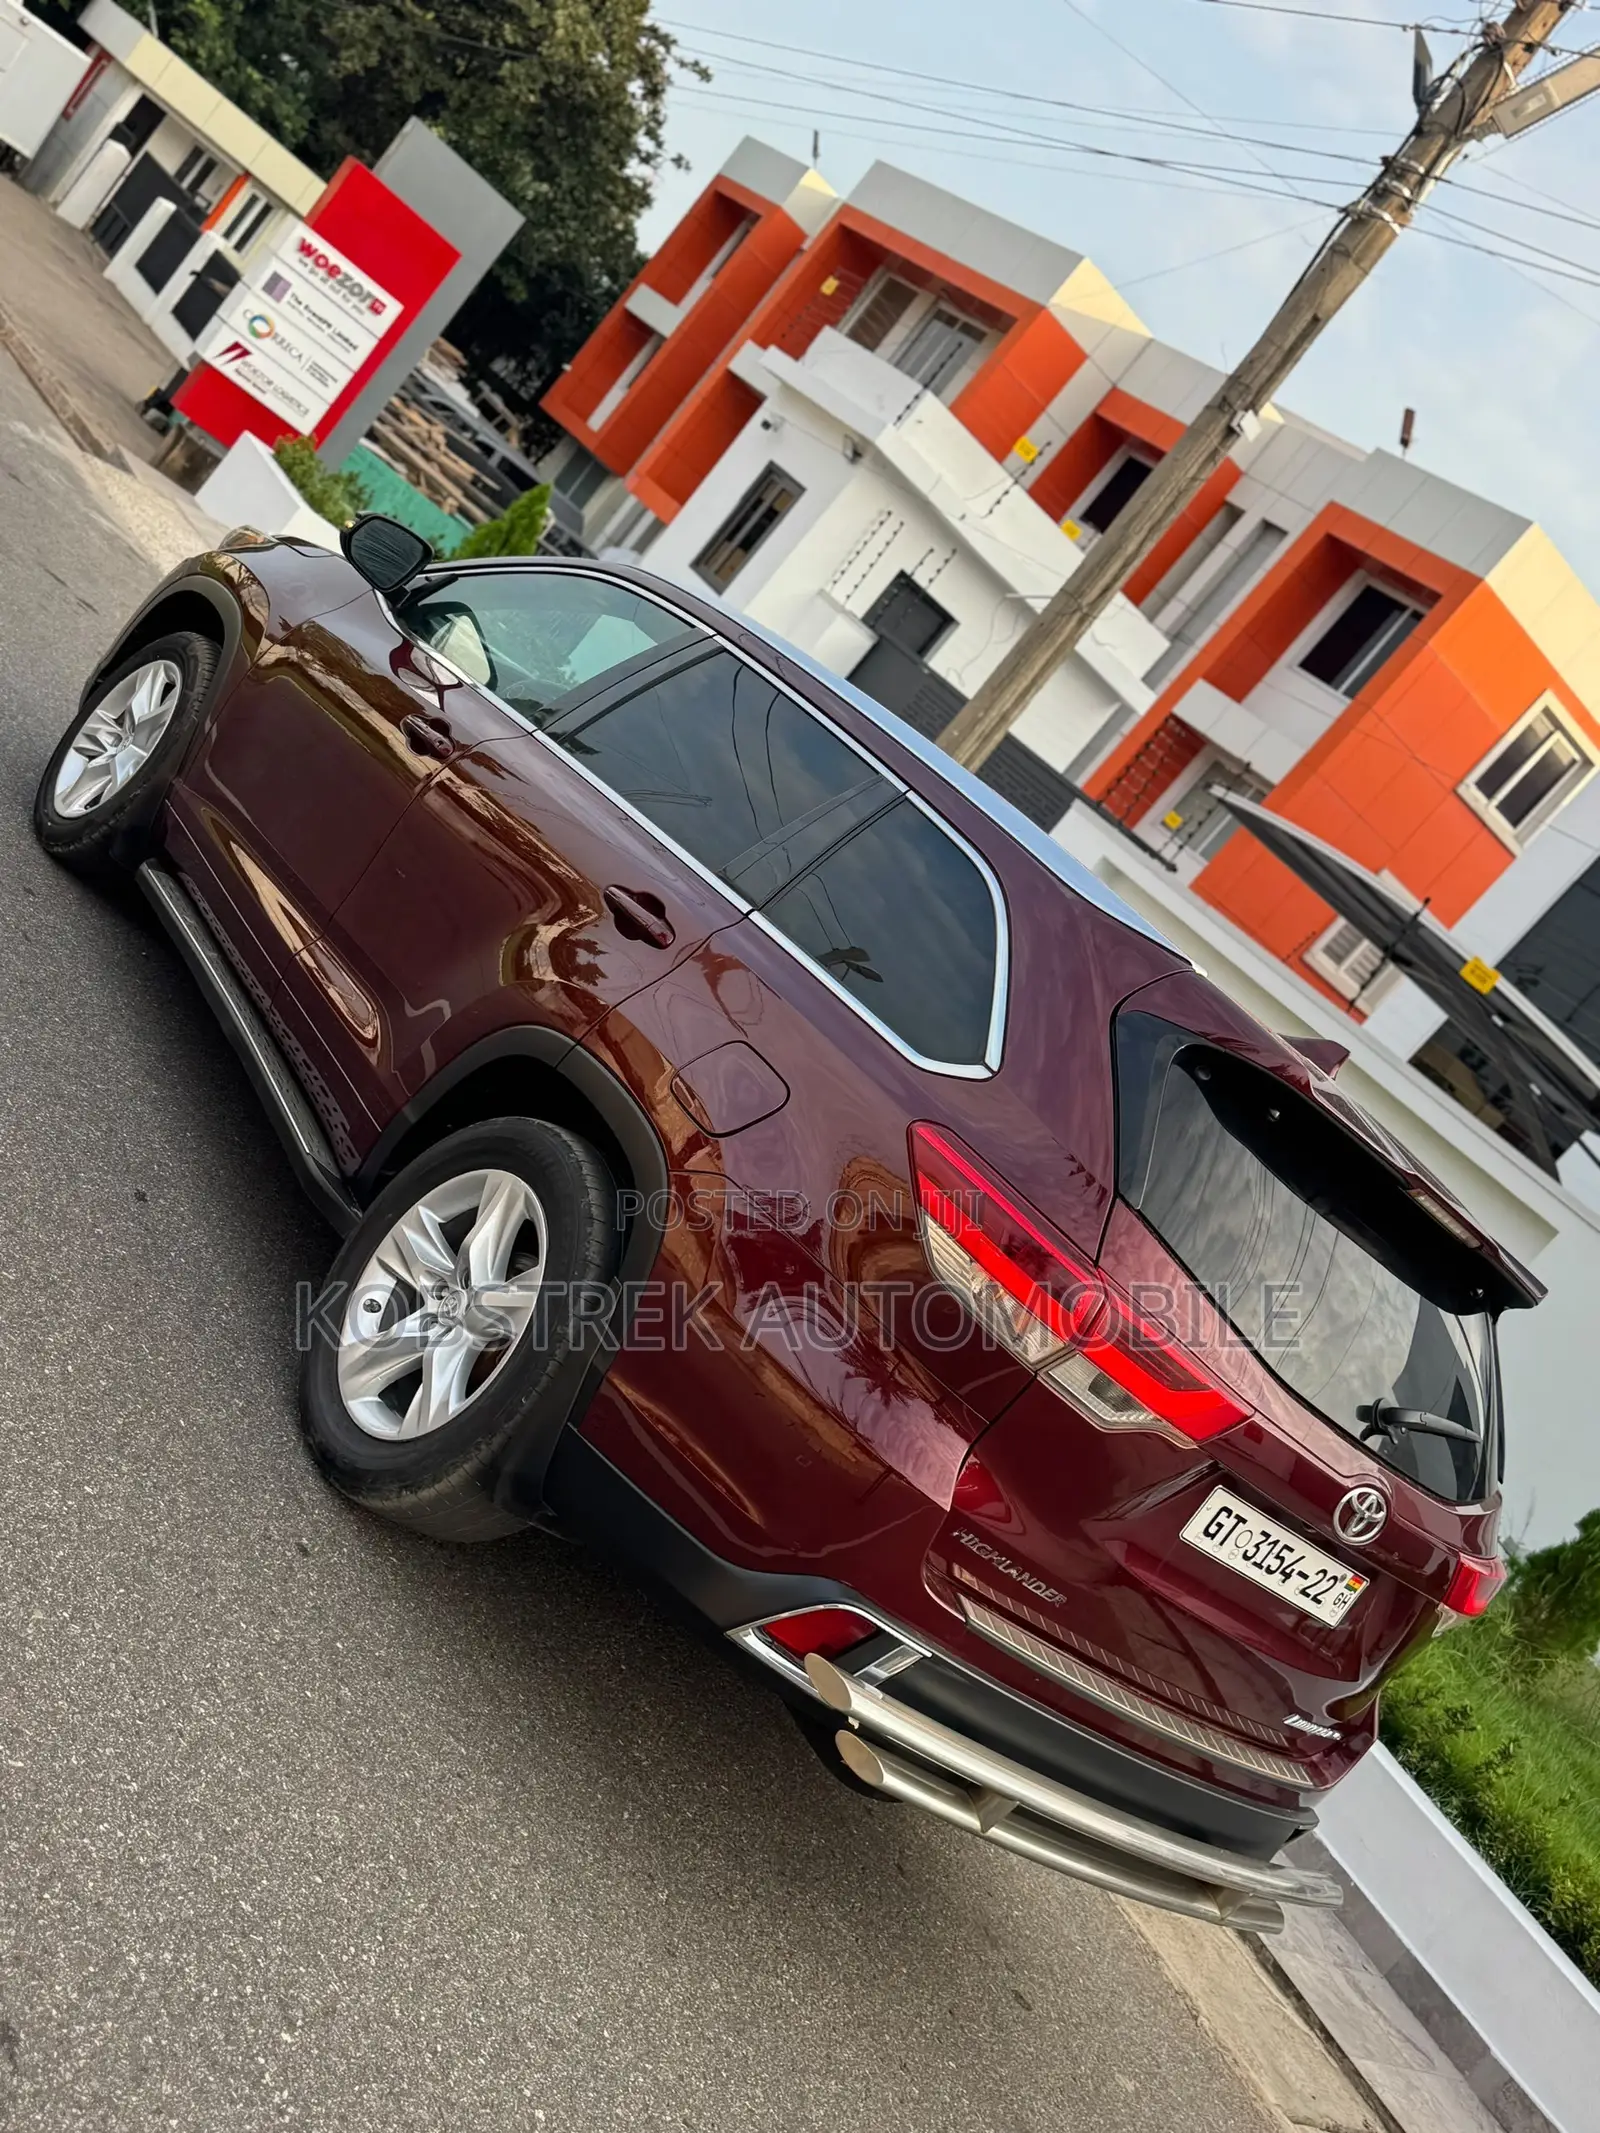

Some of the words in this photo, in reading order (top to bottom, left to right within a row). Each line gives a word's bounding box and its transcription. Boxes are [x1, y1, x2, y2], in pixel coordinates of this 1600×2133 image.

[1202, 1505, 1248, 1547] GT
[1242, 1530, 1339, 1605] 3154-22
[1333, 1591, 1352, 1610] GH
